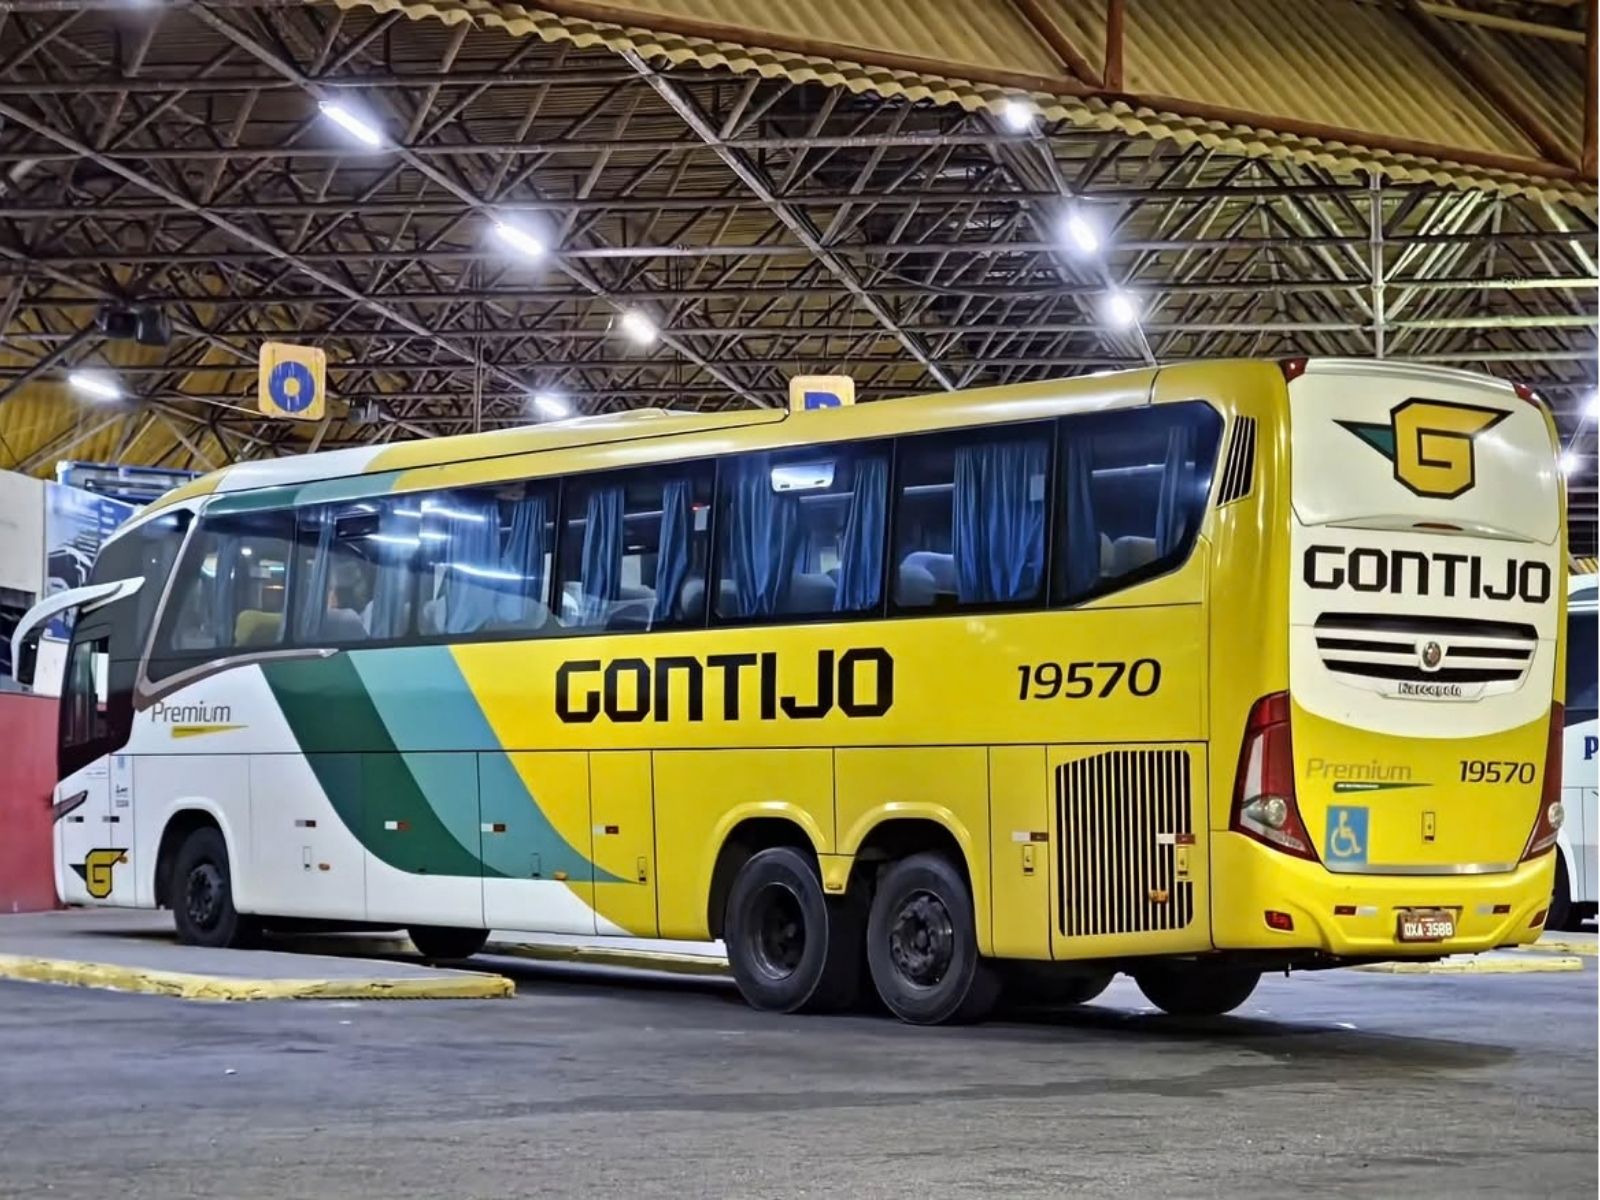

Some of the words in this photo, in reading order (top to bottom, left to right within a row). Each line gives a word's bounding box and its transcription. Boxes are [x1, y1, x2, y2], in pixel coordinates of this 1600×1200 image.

[269, 361, 315, 412] O
[1390, 397, 1514, 499] G
[1303, 544, 1551, 604] GONTIJO
[555, 647, 894, 723] GONTIJO
[1017, 658, 1162, 701] 19570
[151, 700, 231, 723] Premium
[1306, 758, 1412, 781] Premium
[1459, 760, 1536, 784] 19570
[85, 848, 129, 898] G
